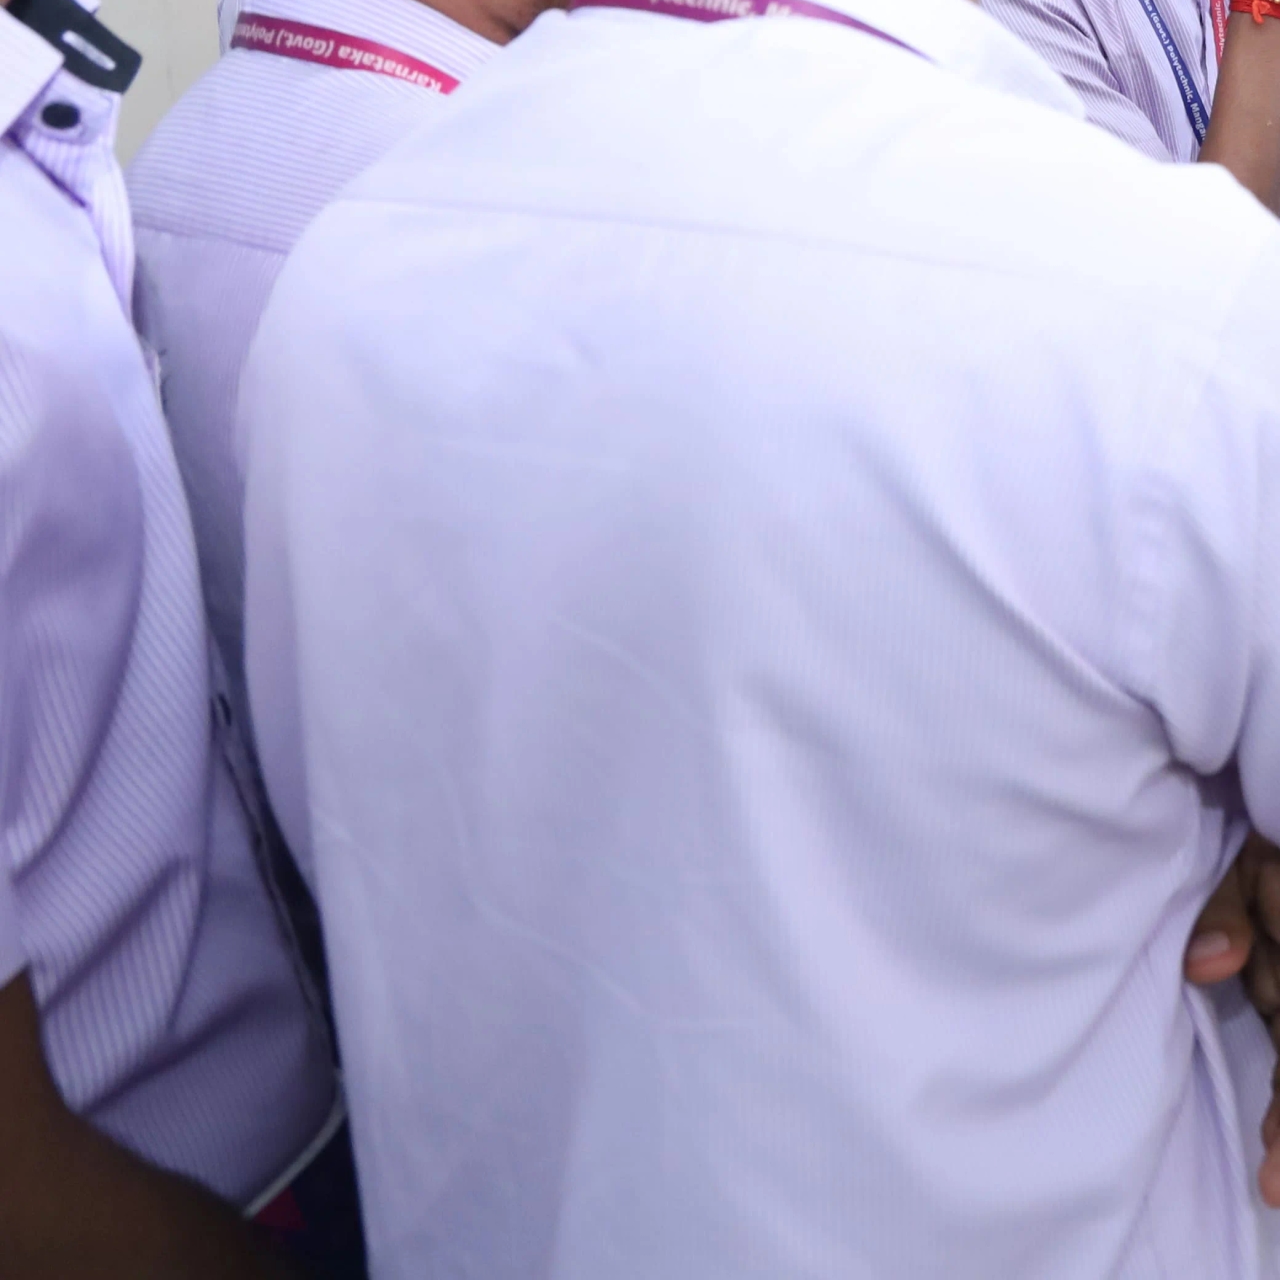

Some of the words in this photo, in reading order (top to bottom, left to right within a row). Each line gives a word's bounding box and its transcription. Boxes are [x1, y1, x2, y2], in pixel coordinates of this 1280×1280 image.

[275, 28, 335, 59] (Govt.)
[1212, 0, 1225, 57] olytechnic,
[338, 45, 443, 94] Karnataka
[1150, 10, 1170, 45] (Govt.)
[1167, 45, 1193, 103] Polytechnic,
[1190, 103, 1208, 140] Manga
